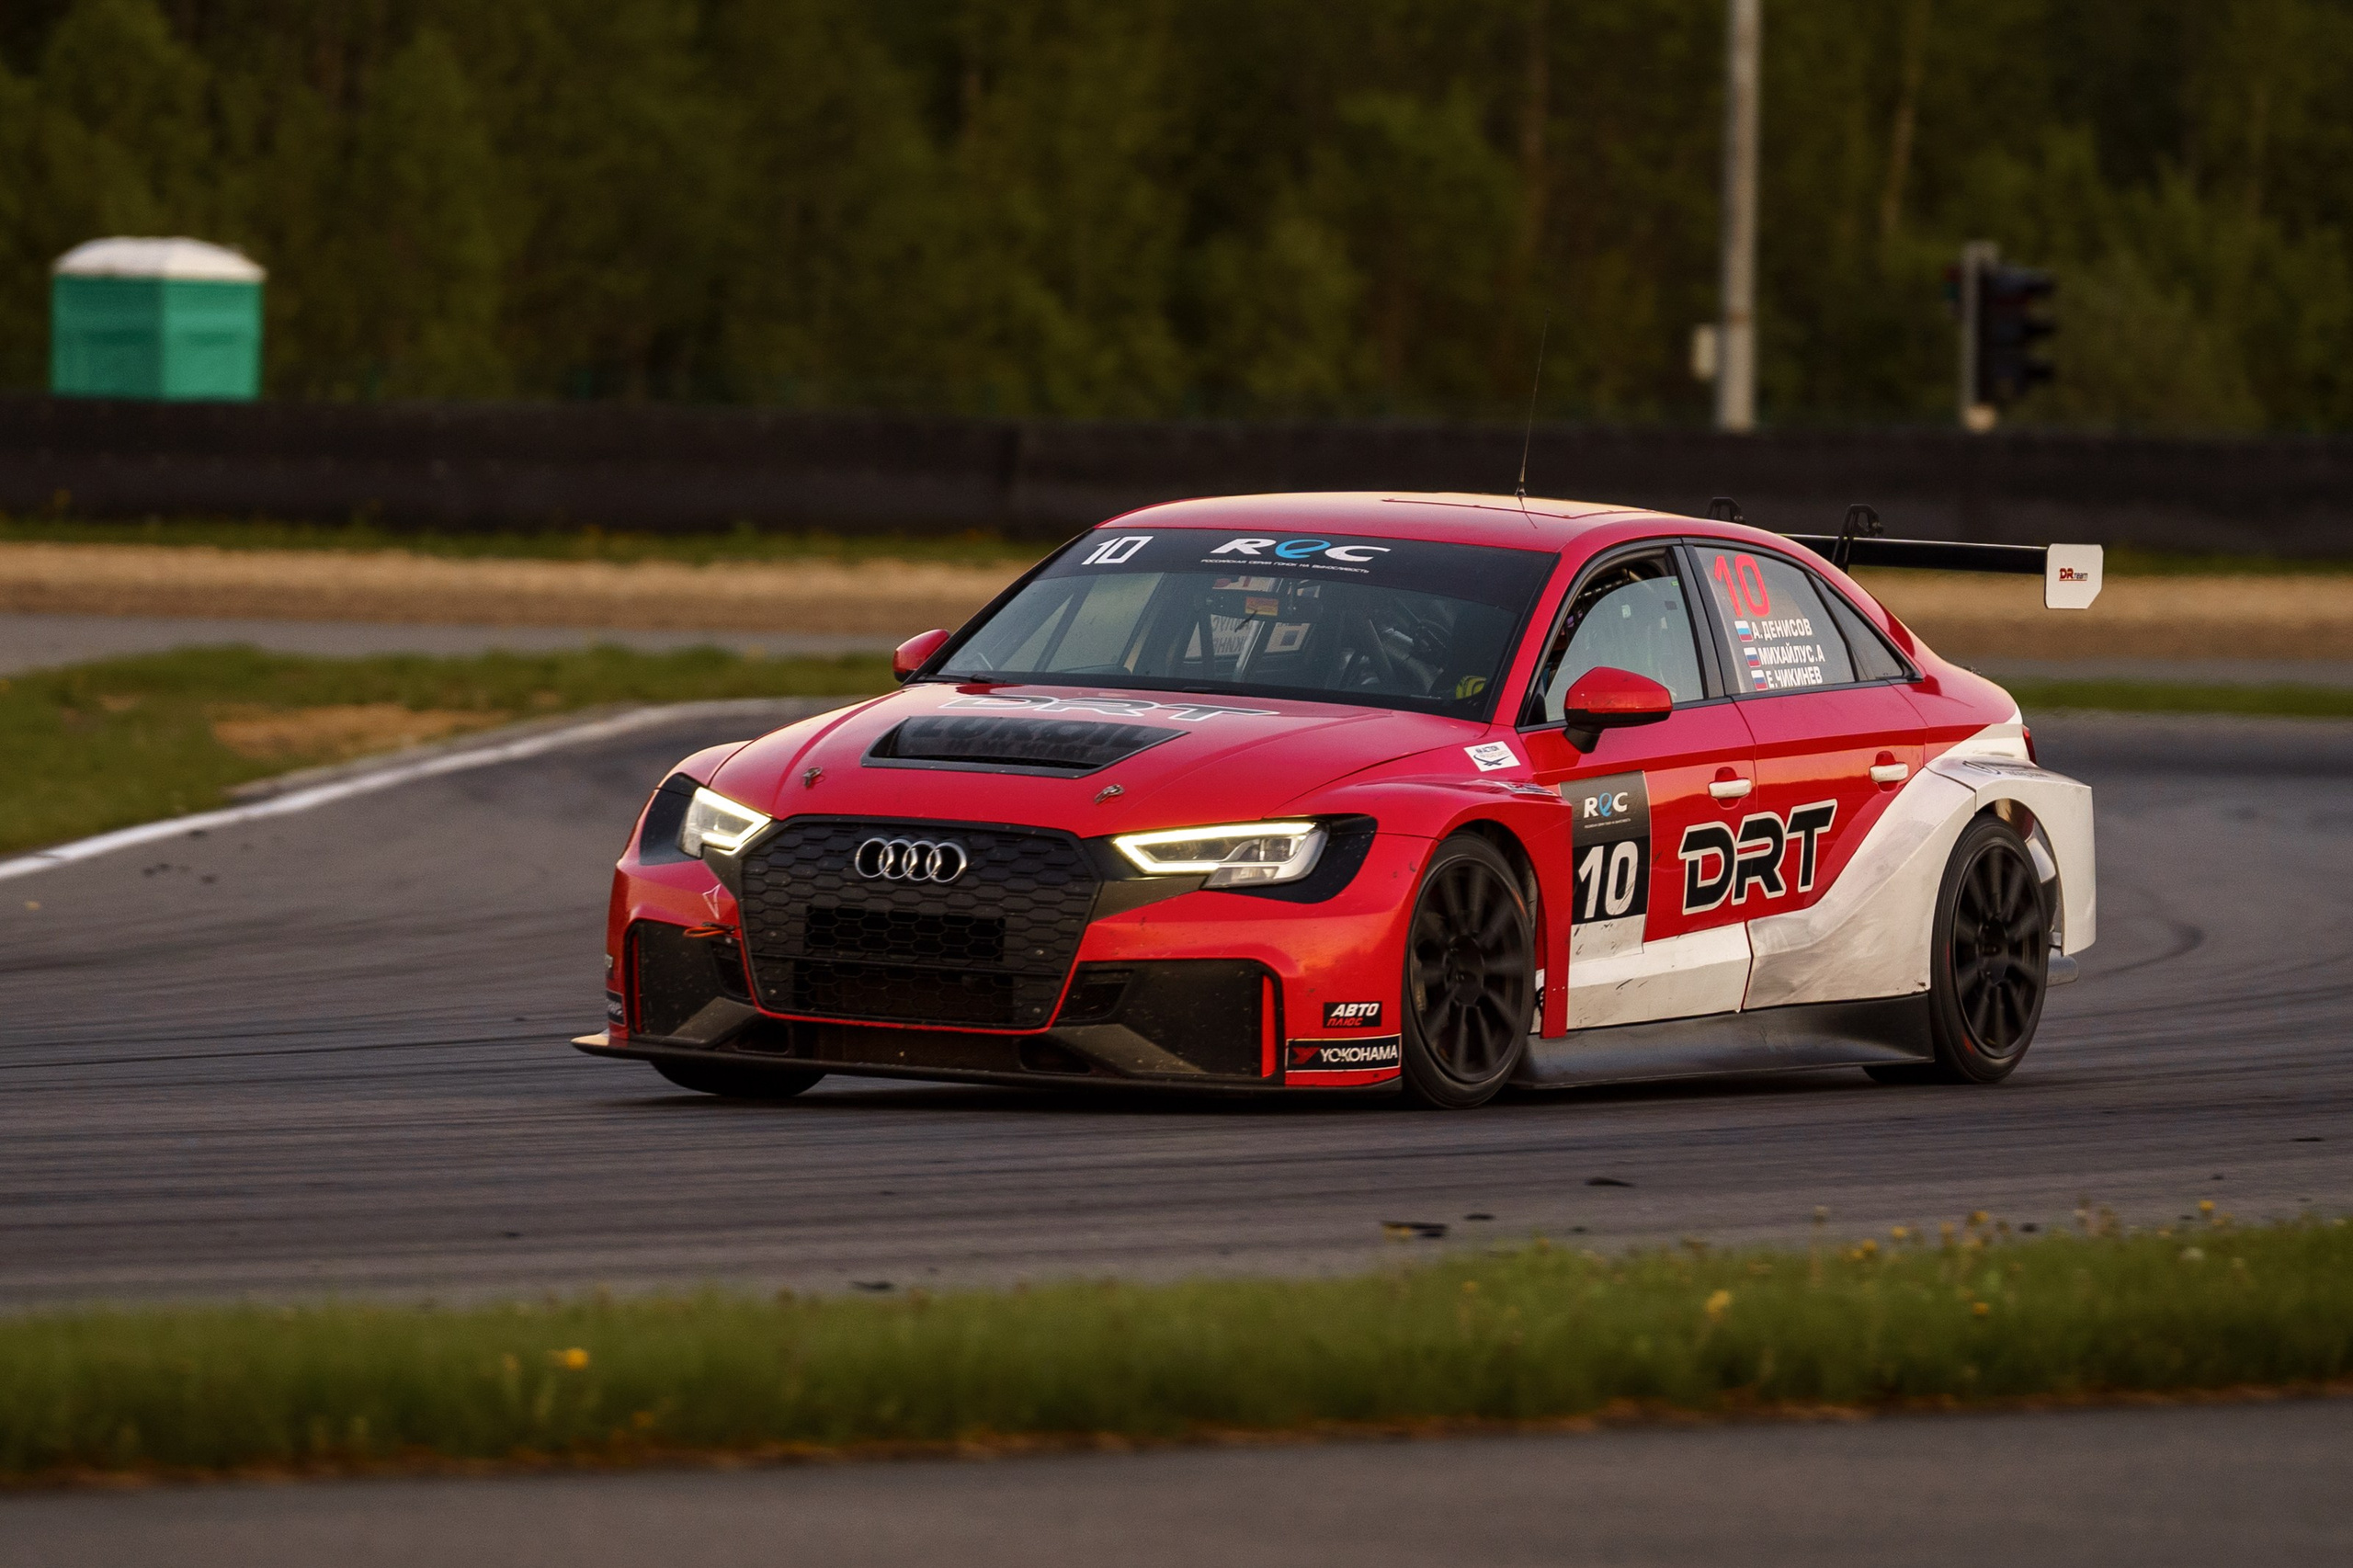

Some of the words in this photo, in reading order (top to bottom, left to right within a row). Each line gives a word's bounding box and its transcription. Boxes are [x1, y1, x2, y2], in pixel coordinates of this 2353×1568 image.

[1082, 536, 1154, 565] 10
[1714, 554, 1770, 617] 10
[938, 695, 1279, 722] DRT
[1678, 799, 1837, 915] DRT
[1578, 841, 1639, 919] 10
[1326, 1017, 1364, 1027] ПЛЮС
[1330, 1003, 1380, 1017] АВТО
[1320, 1044, 1398, 1062] YOKOHAMA
